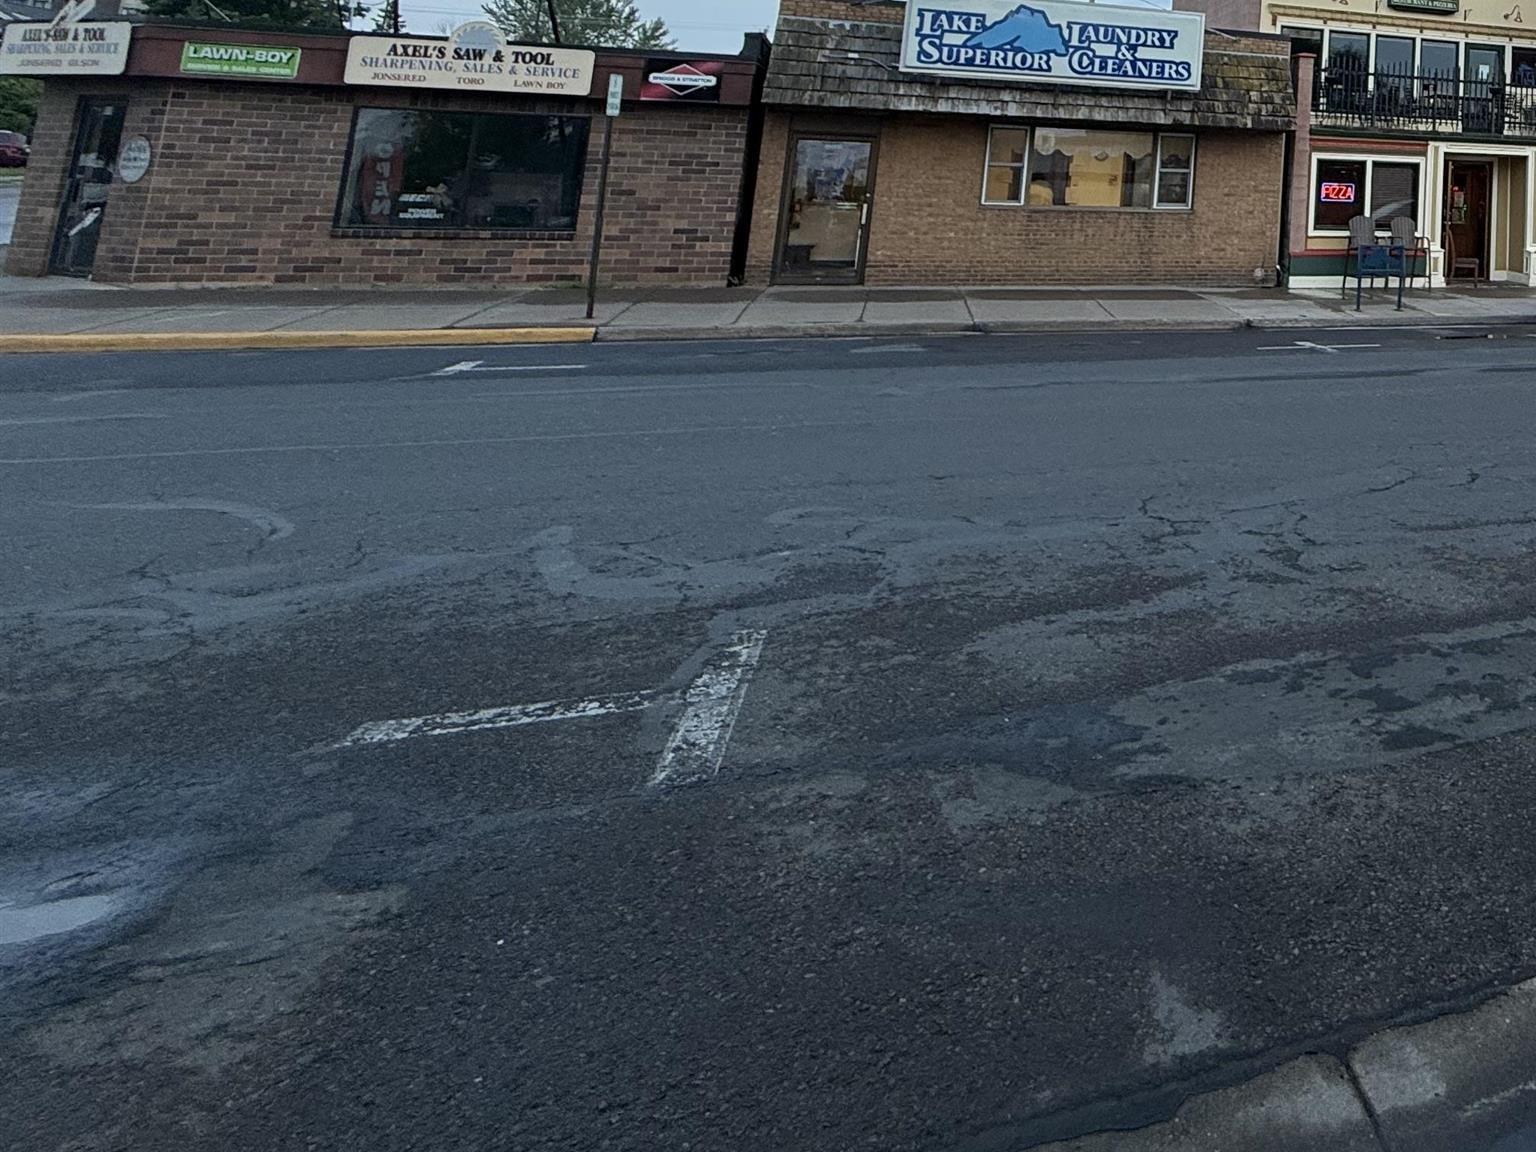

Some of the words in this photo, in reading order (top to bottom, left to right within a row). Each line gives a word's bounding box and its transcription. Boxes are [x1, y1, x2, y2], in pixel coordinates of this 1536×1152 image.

[919, 11, 983, 35] LAKE
[83, 28, 106, 42] TOOL
[1069, 23, 1176, 47] LAUNDRY
[188, 45, 295, 64] LAWN-BOY
[387, 43, 446, 59] AXEL'S
[452, 46, 486, 61] SAW
[493, 49, 504, 62] &
[512, 51, 555, 65] TOOL
[920, 38, 1049, 70] SUPERIOR
[1117, 44, 1137, 61] &
[360, 56, 457, 74] SHARPENING,
[462, 62, 503, 75] SALES
[509, 65, 517, 76] &
[524, 67, 581, 80] SERVICE
[1070, 50, 1191, 80] CLEANERS
[371, 73, 427, 83] JONSERED
[456, 77, 485, 86] TORO
[513, 80, 544, 89] LAWN
[546, 82, 566, 90] BOY
[1321, 185, 1354, 199] PIZZA
